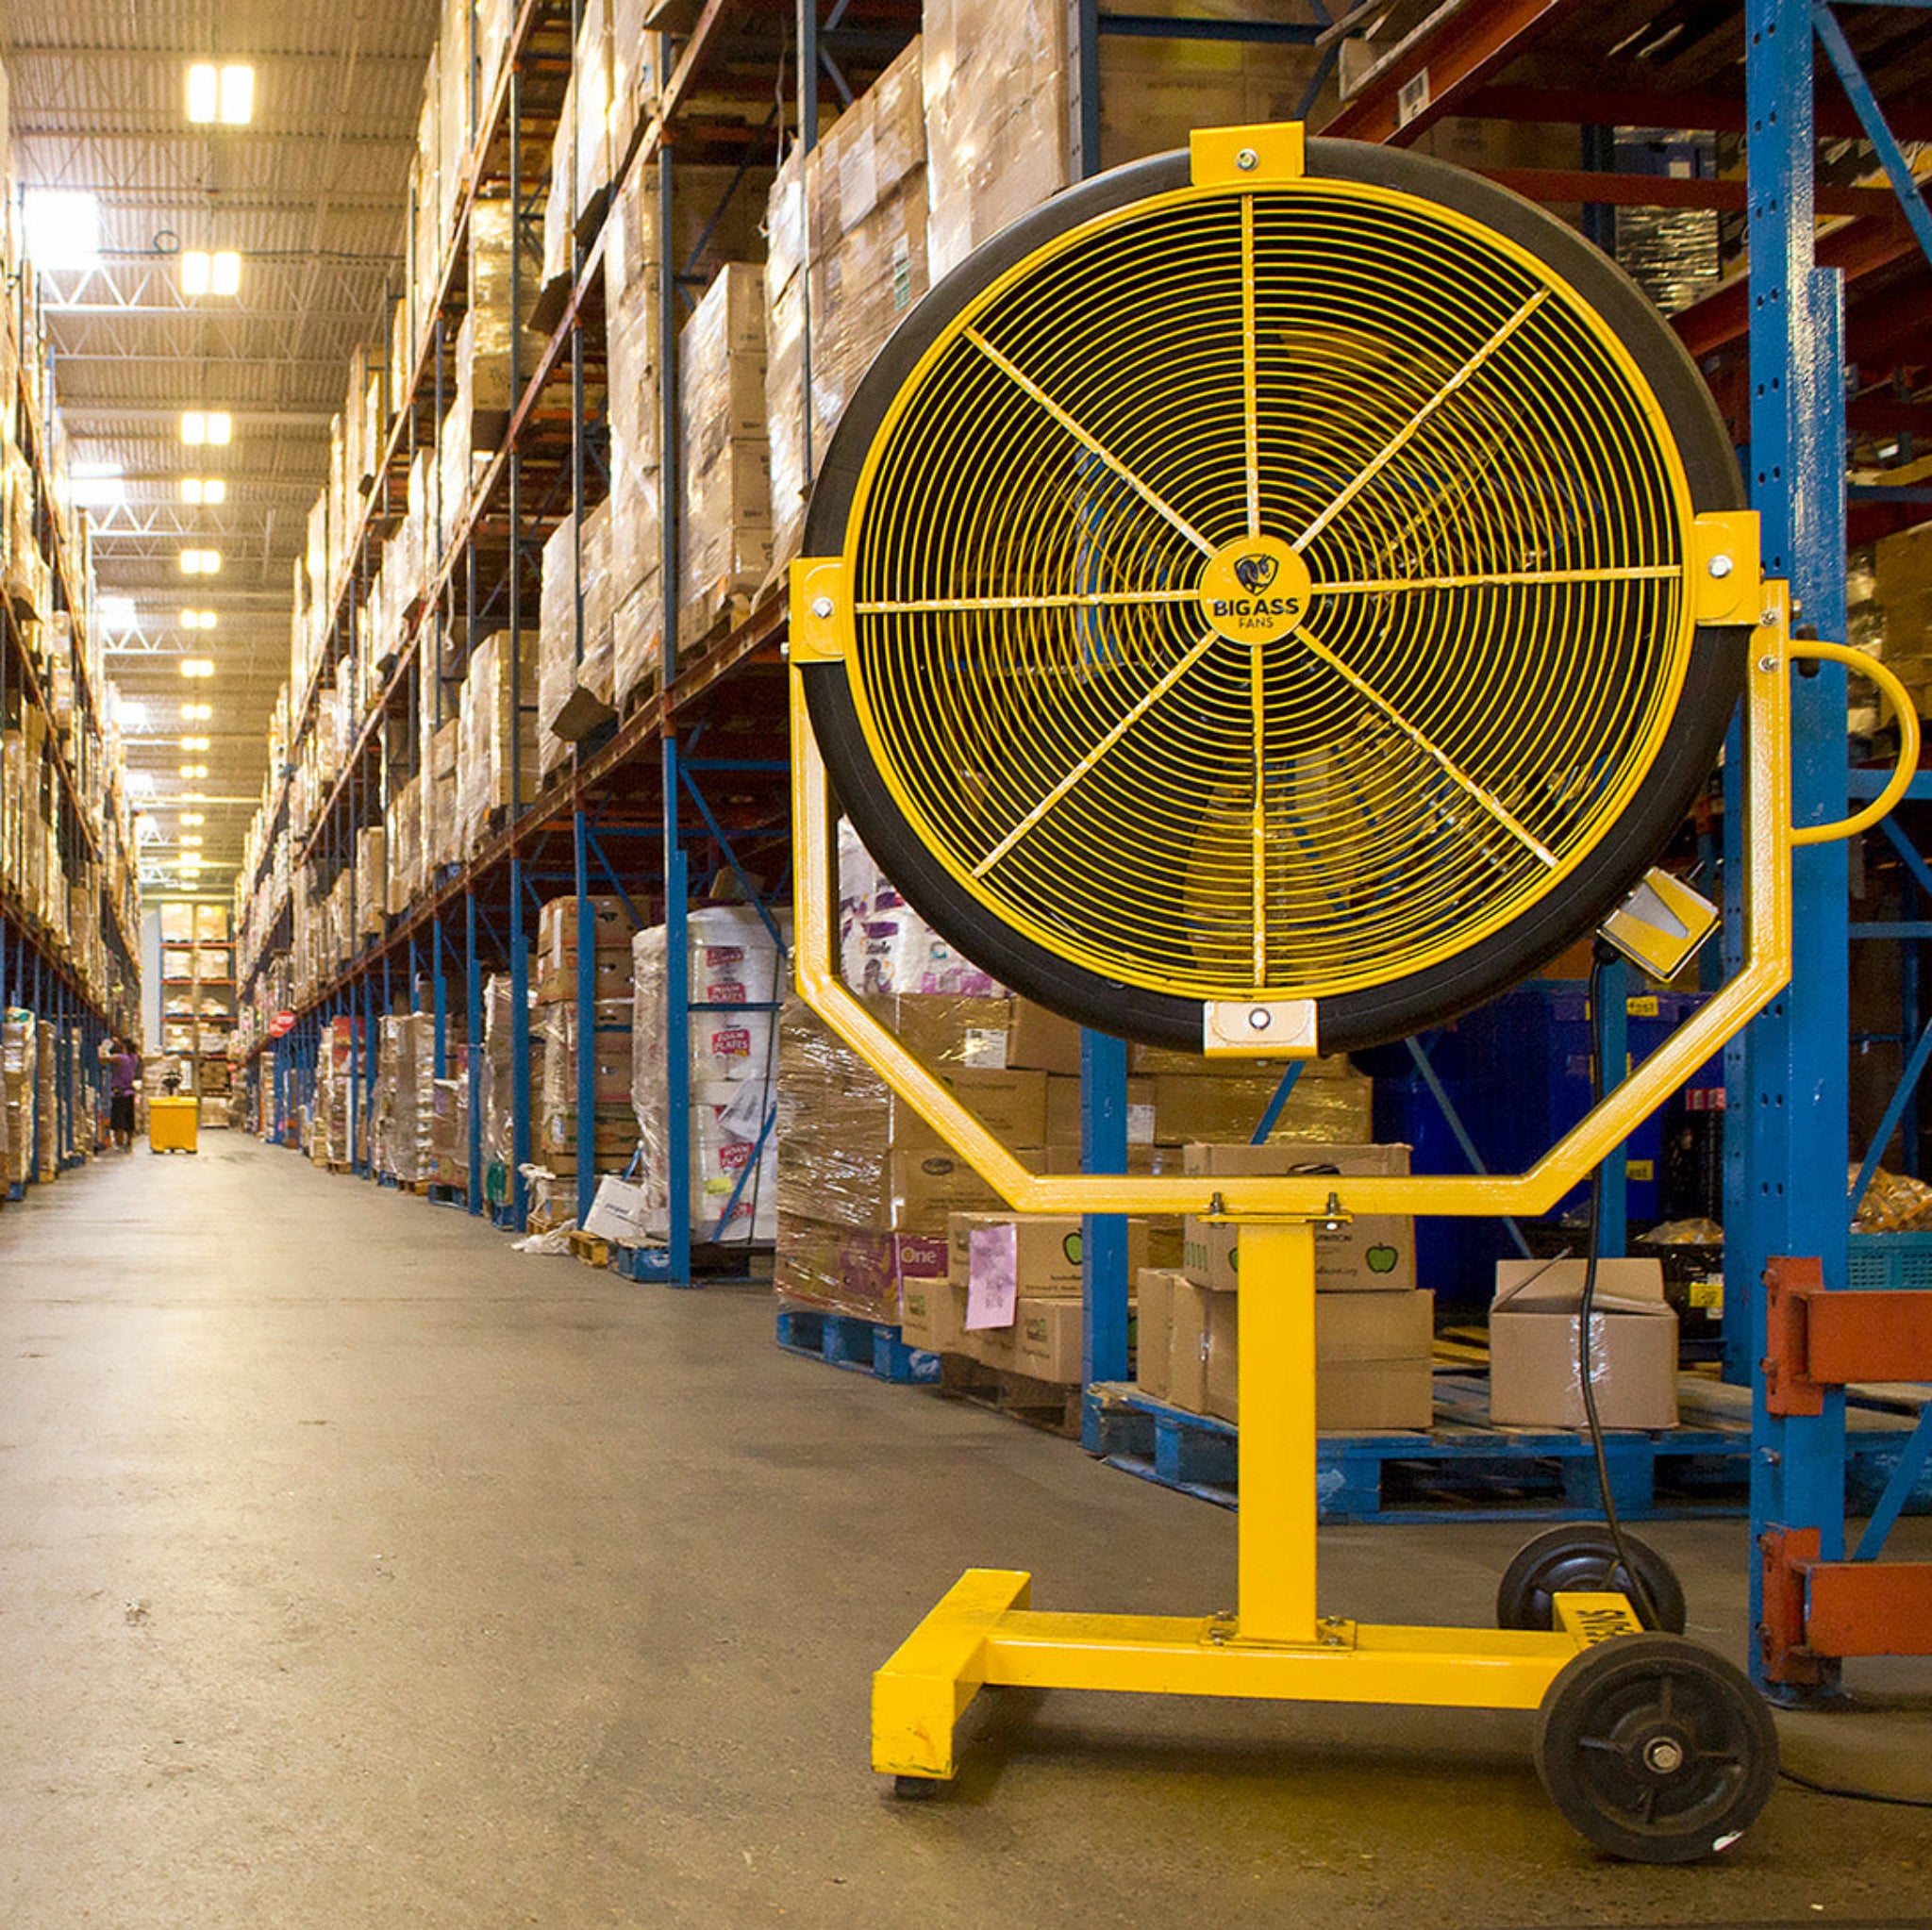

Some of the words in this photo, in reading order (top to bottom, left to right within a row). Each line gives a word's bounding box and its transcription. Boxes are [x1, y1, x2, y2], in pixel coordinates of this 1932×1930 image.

[1239, 617, 1274, 628] FANS
[714, 1040, 748, 1050] PLATES
[901, 1246, 937, 1264] One
